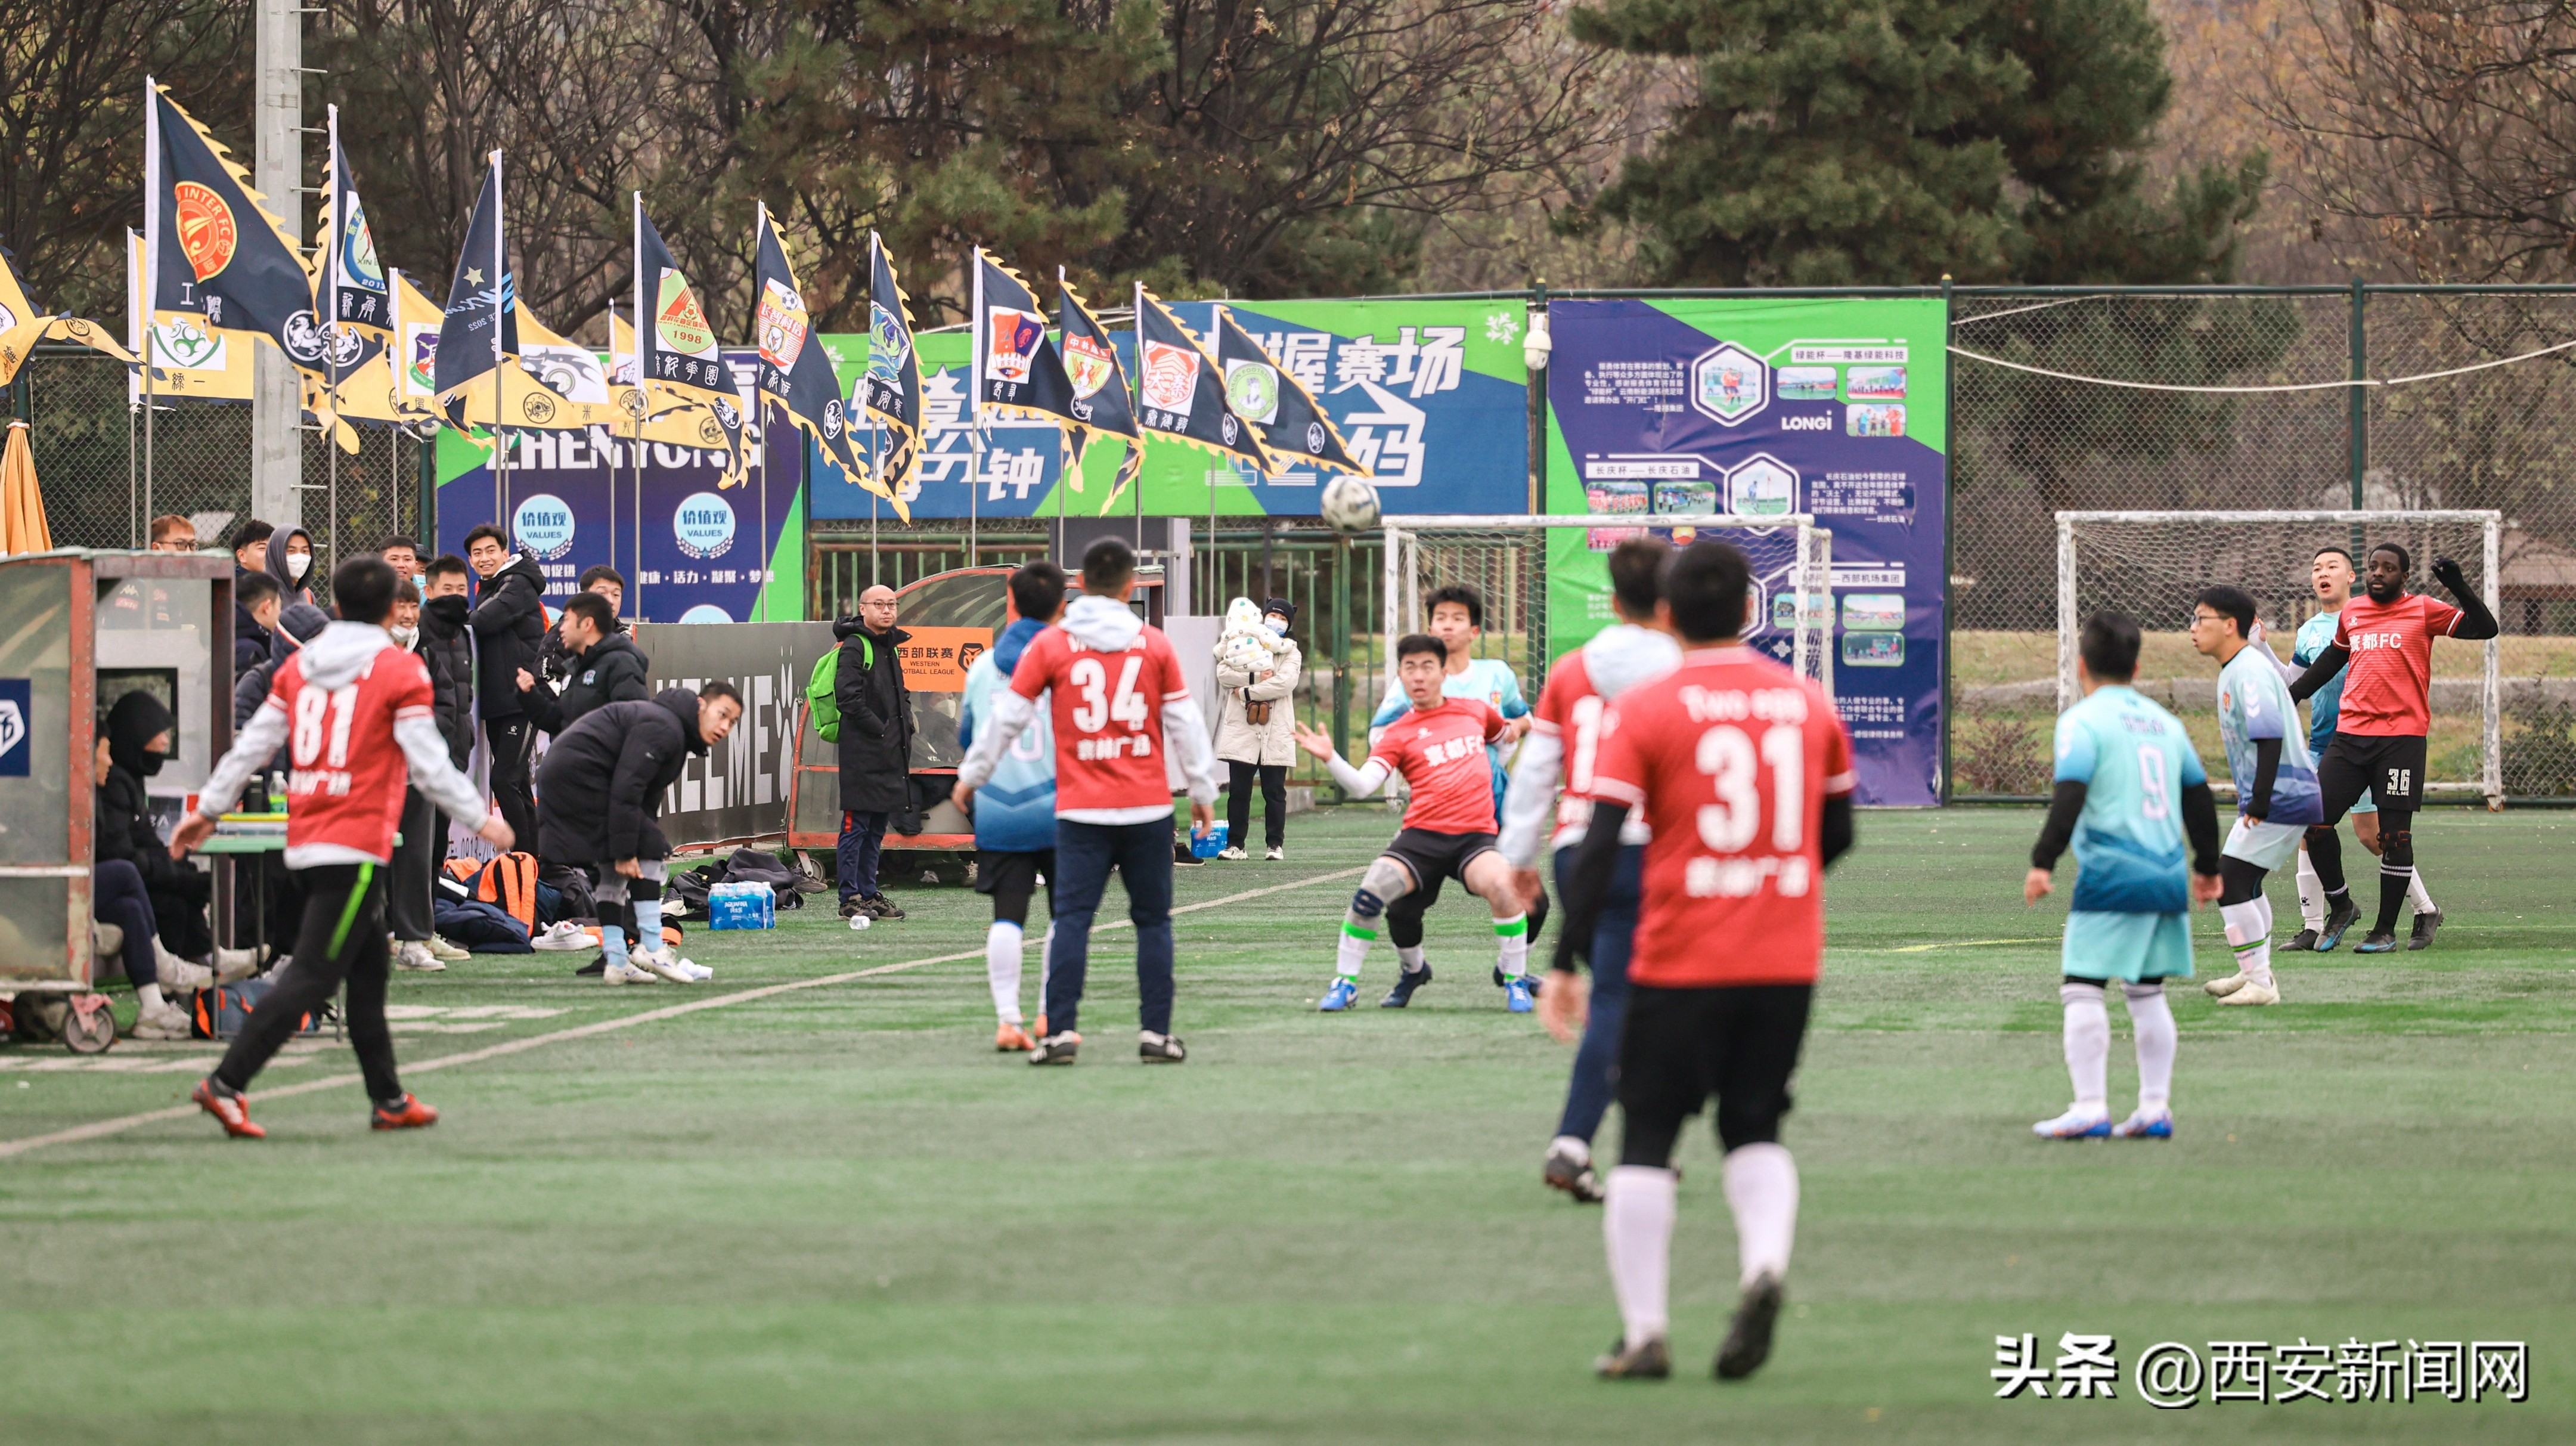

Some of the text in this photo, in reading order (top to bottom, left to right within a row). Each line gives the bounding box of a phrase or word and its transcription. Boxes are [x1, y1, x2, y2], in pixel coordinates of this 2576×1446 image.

[184, 187, 231, 236] INTER FC
[674, 330, 702, 344] 1998
[1204, 326, 1465, 398] 握赛场
[522, 512, 566, 527] 价值观
[683, 510, 727, 525] 价值观
[898, 647, 953, 659] 西部联赛
[1070, 656, 1148, 733] 34
[293, 683, 359, 769] 81
[1695, 724, 1805, 853] 31
[2138, 745, 2168, 820] 9
[2388, 768, 2410, 791] 36
